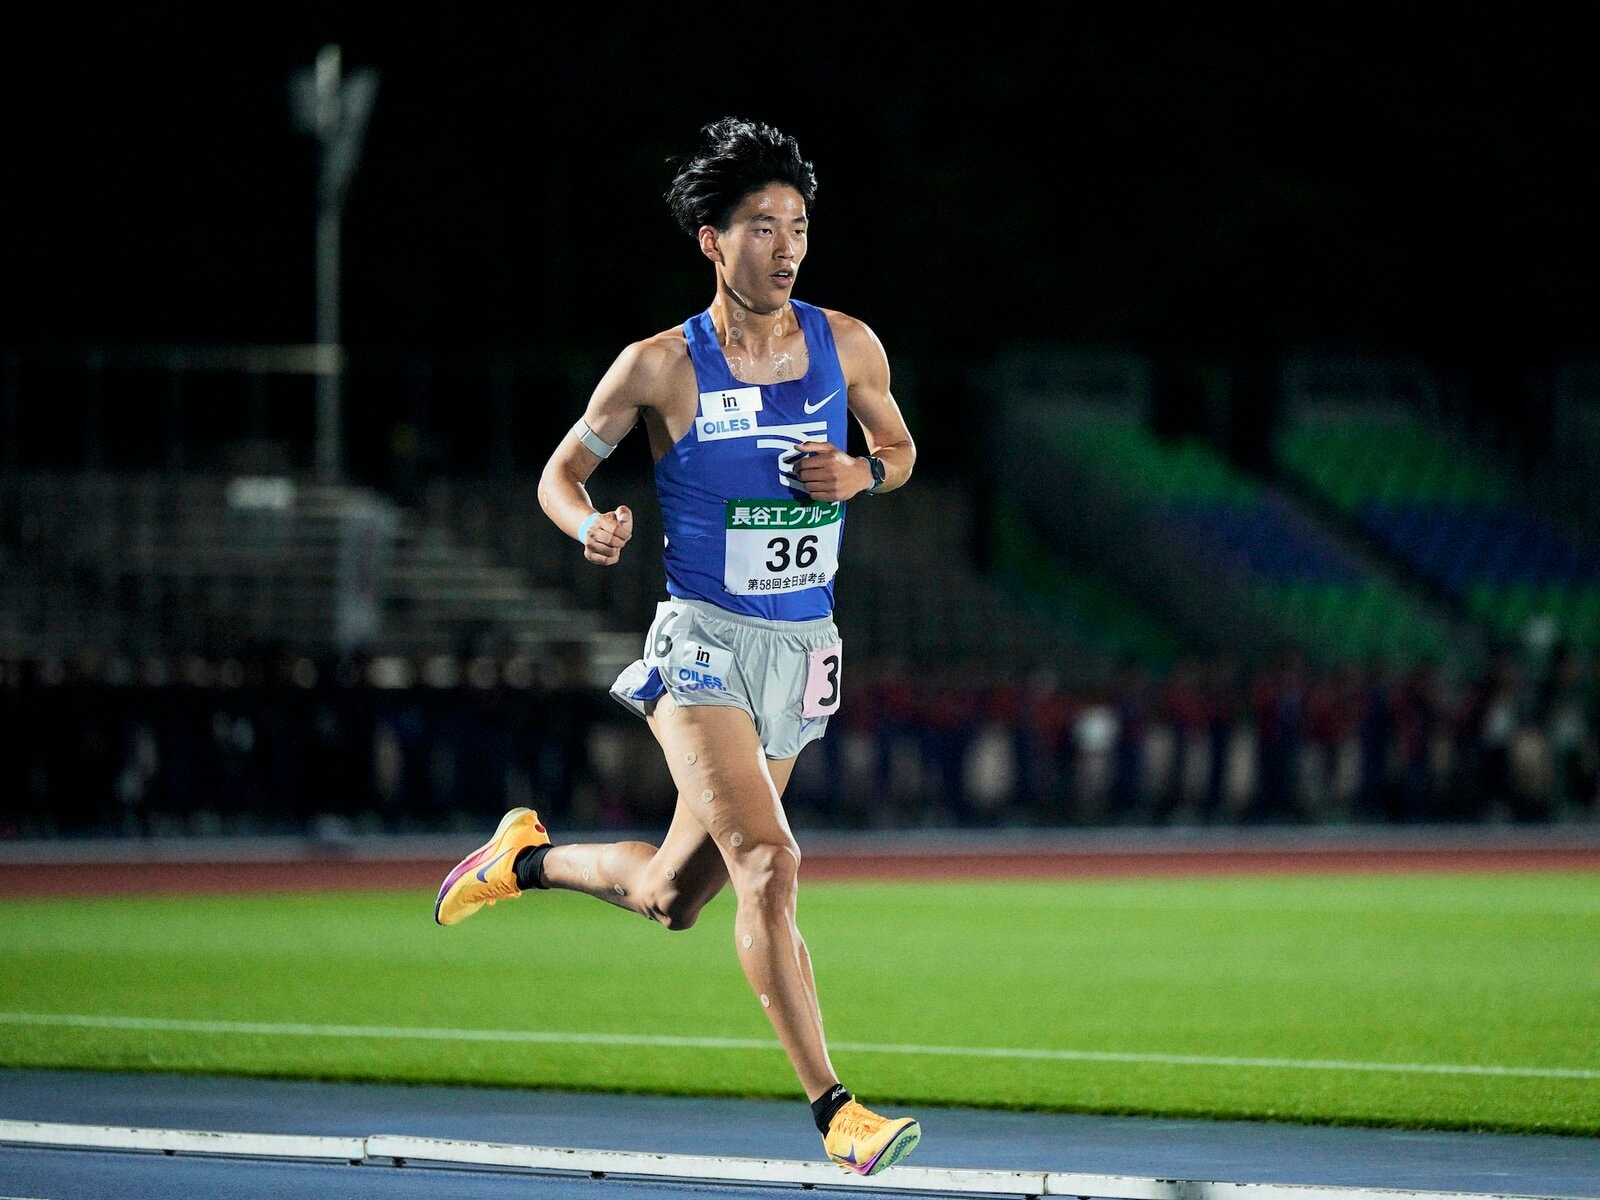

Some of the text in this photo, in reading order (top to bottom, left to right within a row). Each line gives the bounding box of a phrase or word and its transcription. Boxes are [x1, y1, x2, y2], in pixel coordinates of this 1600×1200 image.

[722, 393, 738, 408] in
[703, 418, 750, 435] OILES
[765, 534, 819, 573] 36
[747, 572, 826, 591] 第58回全日選考会
[646, 611, 679, 659] 6
[696, 645, 711, 664] in
